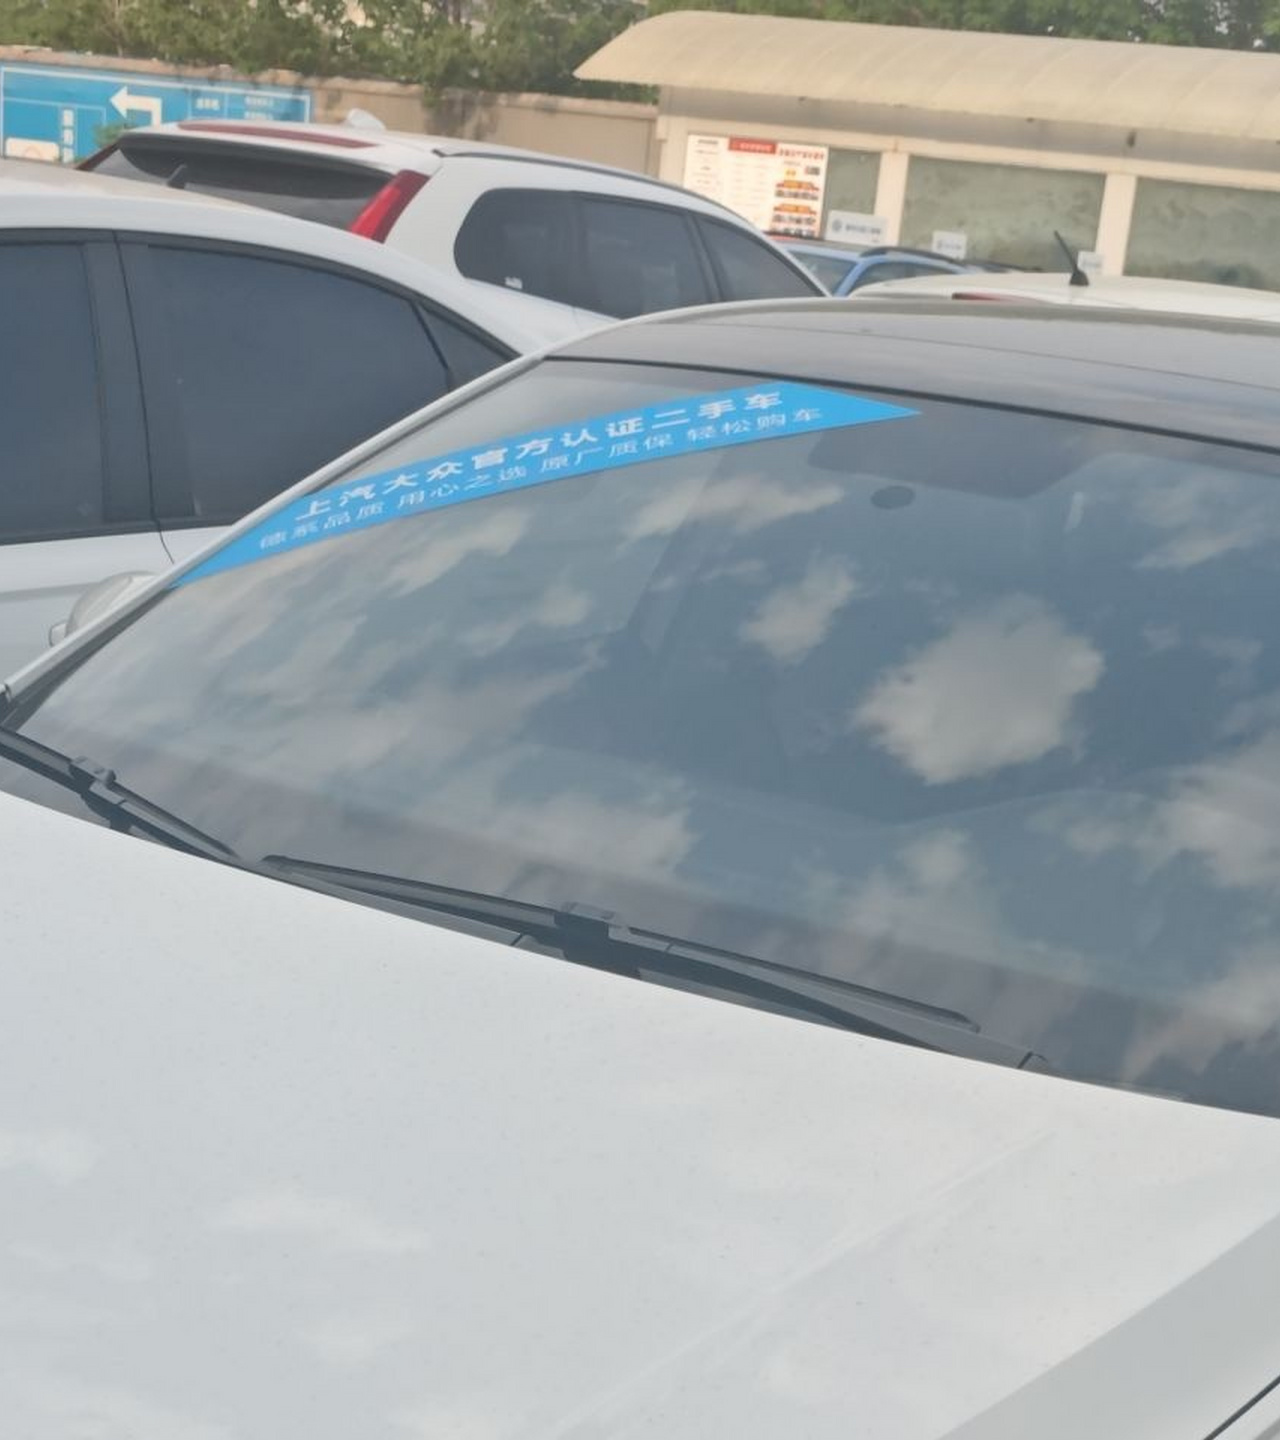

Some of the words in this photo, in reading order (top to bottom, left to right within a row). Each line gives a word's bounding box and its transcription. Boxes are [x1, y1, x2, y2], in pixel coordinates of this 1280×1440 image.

[294, 391, 783, 521] 上汽大众官方认证二手车
[397, 465, 526, 509] 用心之选
[539, 433, 673, 473] 原厂质保
[686, 407, 822, 442] 轻松购车
